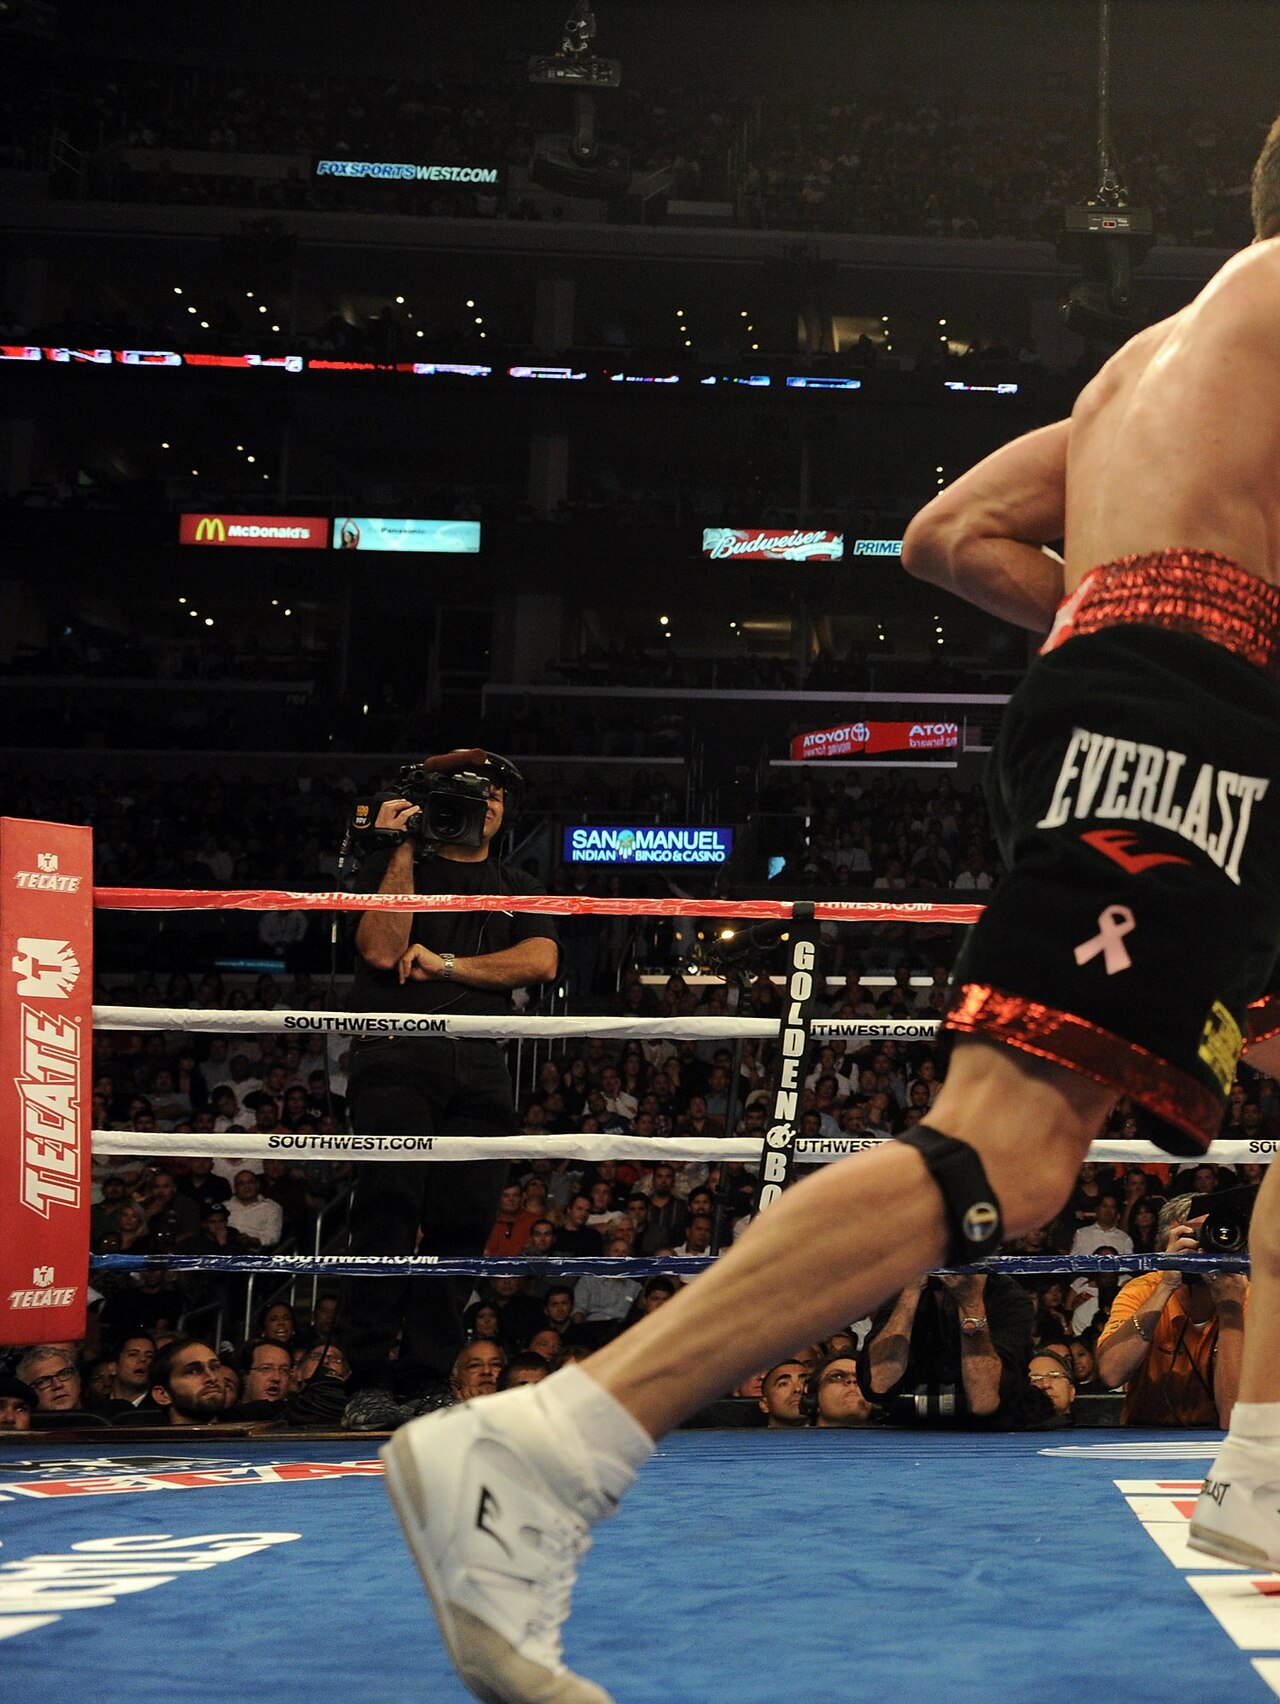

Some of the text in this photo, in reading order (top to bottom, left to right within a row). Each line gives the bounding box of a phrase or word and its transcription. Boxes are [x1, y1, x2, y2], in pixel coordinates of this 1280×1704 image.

[228, 524, 311, 540] McDonald's
[710, 529, 827, 560] Budweiser
[1036, 727, 1270, 886] EVERLAST
[572, 829, 725, 850] SAN MANUEL
[572, 849, 616, 861] INDIAN
[13, 871, 83, 893] TECATE
[284, 1016, 447, 1032] SOUTHWEST.COM
[774, 940, 816, 1121] GOLDEN
[13, 1001, 81, 1221] TECATE
[268, 1135, 434, 1151] SOUTHWEST.COM
[8, 1286, 78, 1310] TECATE
